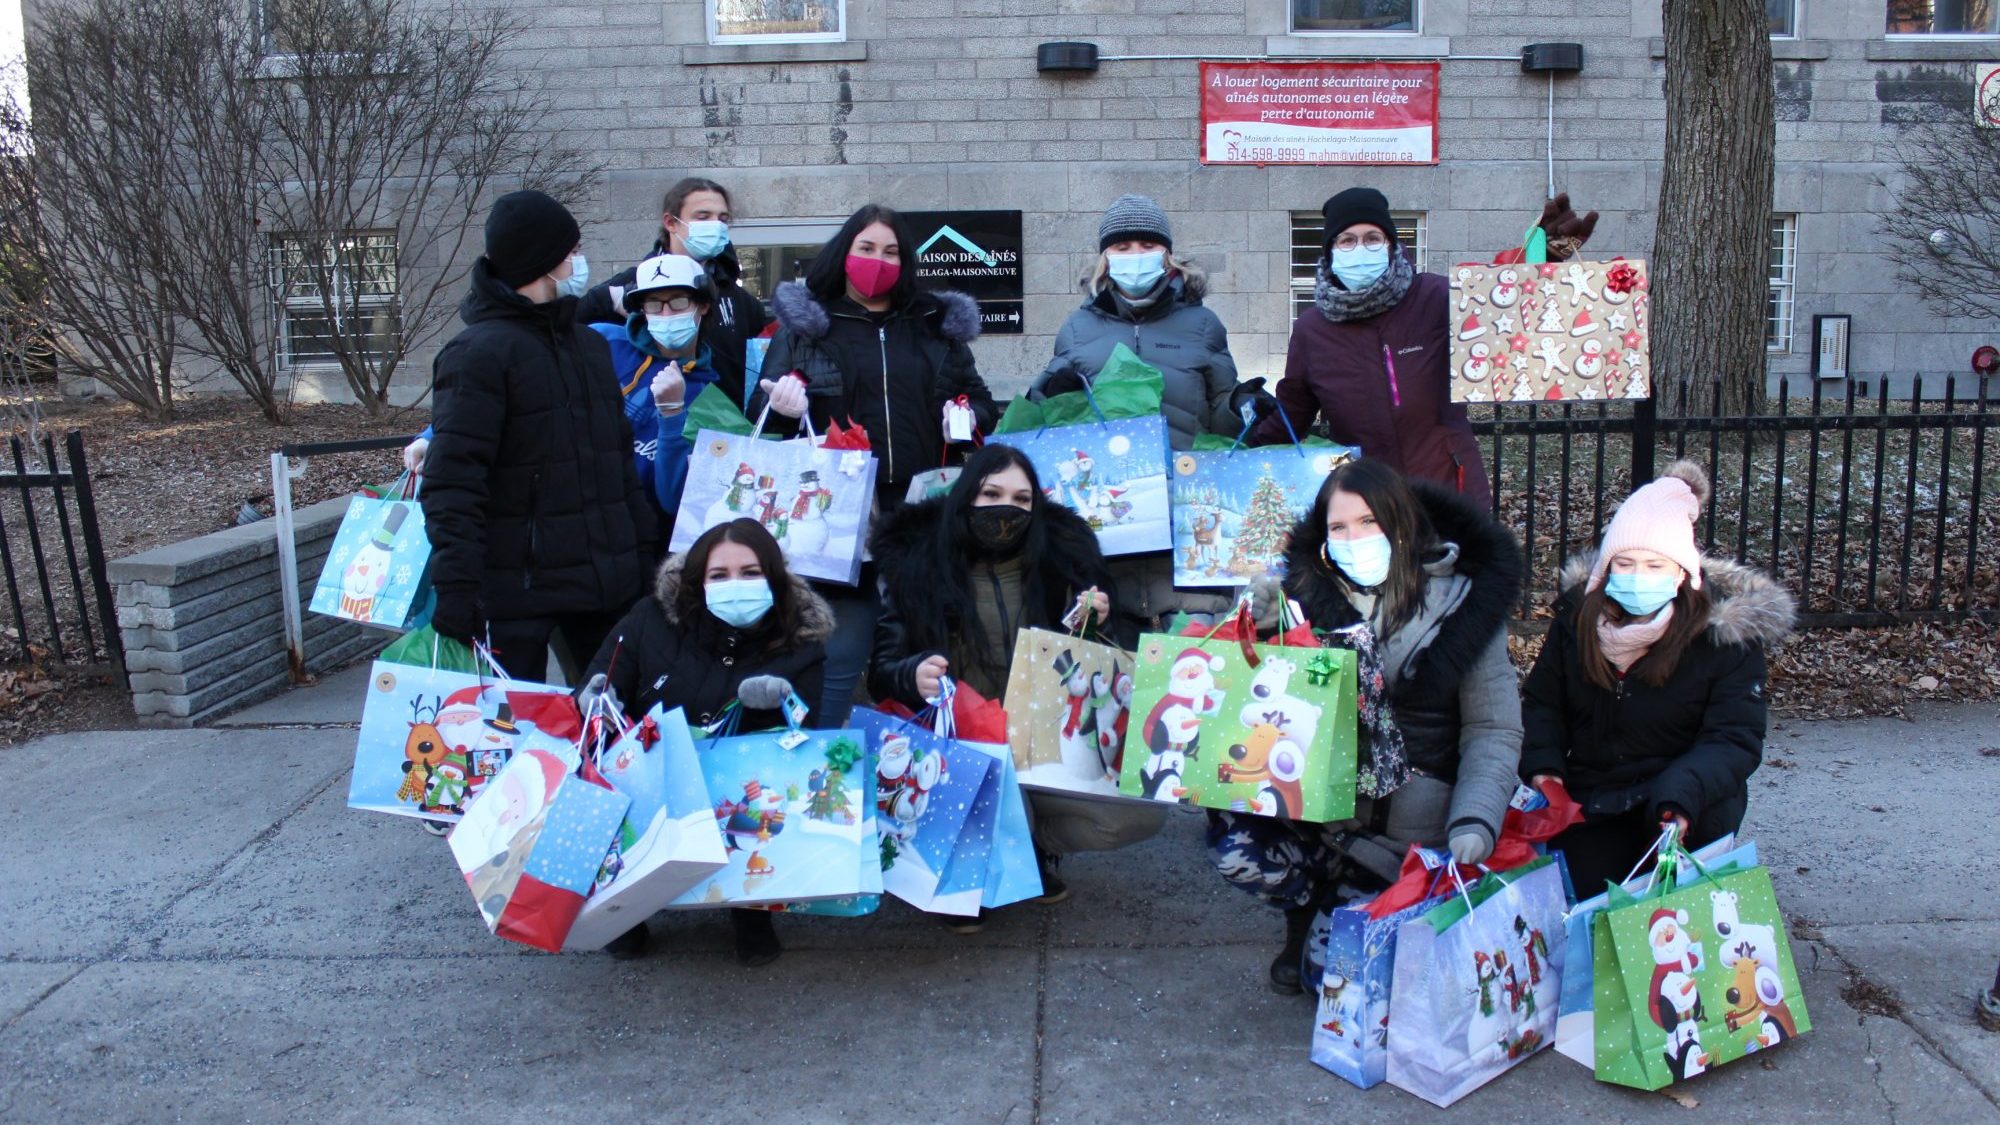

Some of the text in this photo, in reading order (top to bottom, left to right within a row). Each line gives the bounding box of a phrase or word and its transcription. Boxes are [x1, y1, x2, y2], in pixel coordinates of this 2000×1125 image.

[1212, 73, 1423, 90] À louer logement sécuritaire pour
[1225, 91, 1409, 106] aînés autonomes ou en légère
[1261, 107, 1375, 121] perte d'autonomie
[1243, 135, 1271, 143] Maison
[1273, 135, 1285, 143] des
[1227, 147, 1305, 161] 514-598-9999
[959, 251, 981, 263] DES
[983, 249, 1017, 263] AÎNÉS
